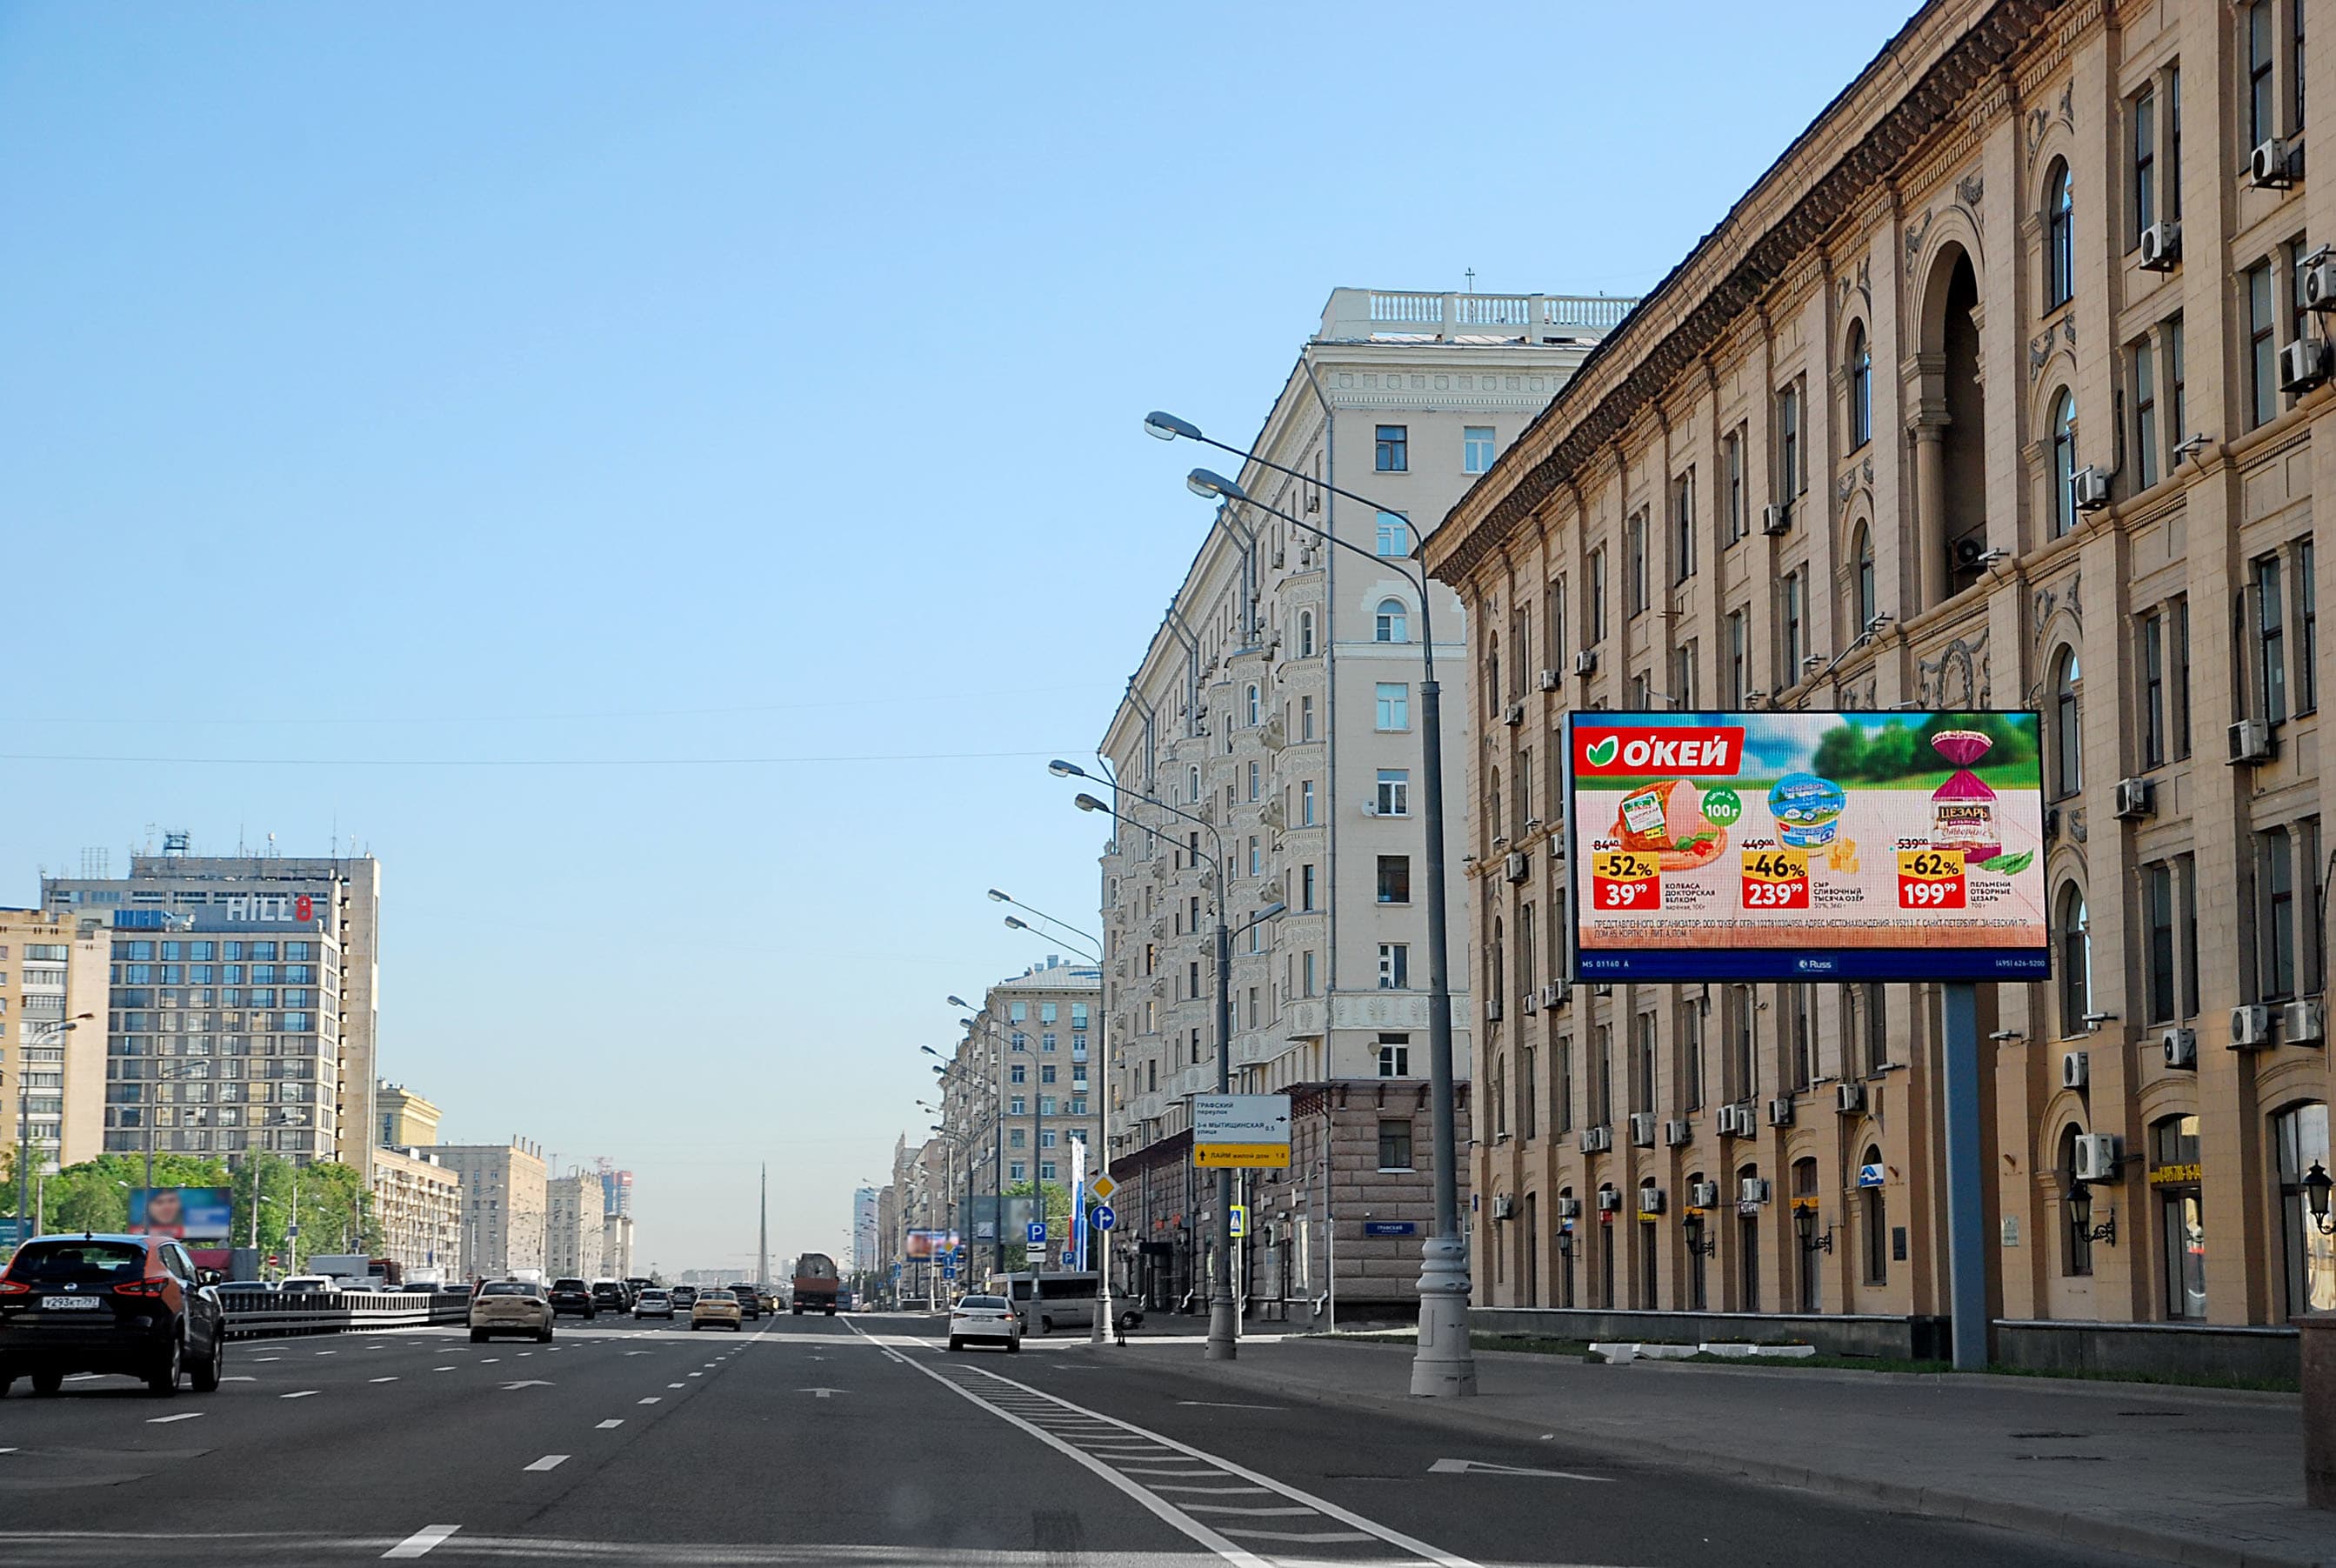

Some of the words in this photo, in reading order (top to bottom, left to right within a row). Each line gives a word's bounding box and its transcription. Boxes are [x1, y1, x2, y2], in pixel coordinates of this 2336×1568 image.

[1705, 804, 1731, 817] 100
[1940, 806, 1988, 819] ЦЕЗАРЬ
[1598, 855, 1652, 877] -52%
[1745, 854, 1805, 877] -46%
[1904, 853, 1959, 875] -62%
[1805, 919, 1825, 928] АДРЕС
[1809, 959, 1832, 969] Russ
[1031, 1224, 1043, 1240] P
